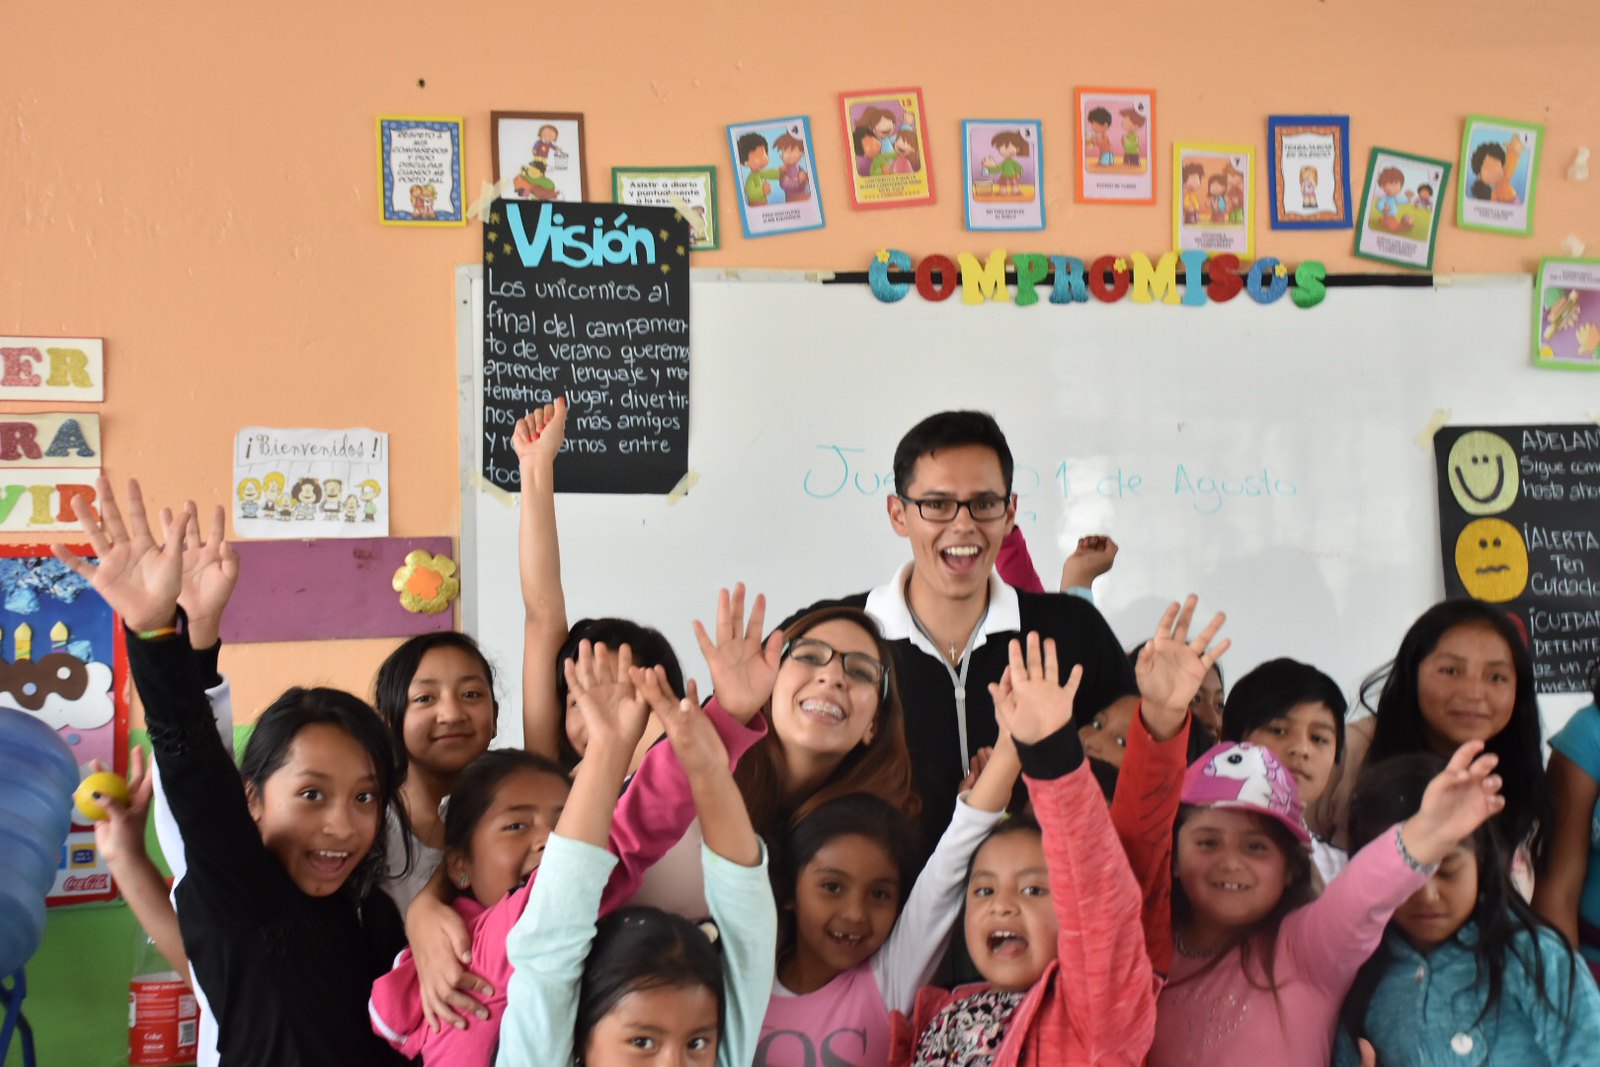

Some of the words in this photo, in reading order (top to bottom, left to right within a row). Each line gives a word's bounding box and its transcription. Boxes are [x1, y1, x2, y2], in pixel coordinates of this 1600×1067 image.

[506, 202, 656, 268] Visión
[489, 267, 527, 298] Los
[535, 277, 641, 301] unicornios
[648, 281, 670, 307] al
[868, 249, 1327, 309] COMPROMISOS
[486, 300, 537, 336] final
[543, 312, 576, 338] del
[485, 331, 507, 356] to
[513, 338, 539, 361] de
[549, 343, 611, 361] verano
[483, 359, 560, 385] aprender
[571, 362, 648, 389] lenguaje
[650, 367, 660, 389] y
[485, 405, 515, 426] nos
[577, 409, 612, 431] más
[617, 410, 680, 436] amigos
[618, 435, 671, 454] entre
[1522, 428, 1600, 452] ADELAN
[1520, 454, 1566, 481] Sigue
[1570, 461, 1600, 475] com
[1096, 468, 1144, 499] de
[1522, 478, 1565, 501] hasta
[1550, 554, 1584, 575] Ten
